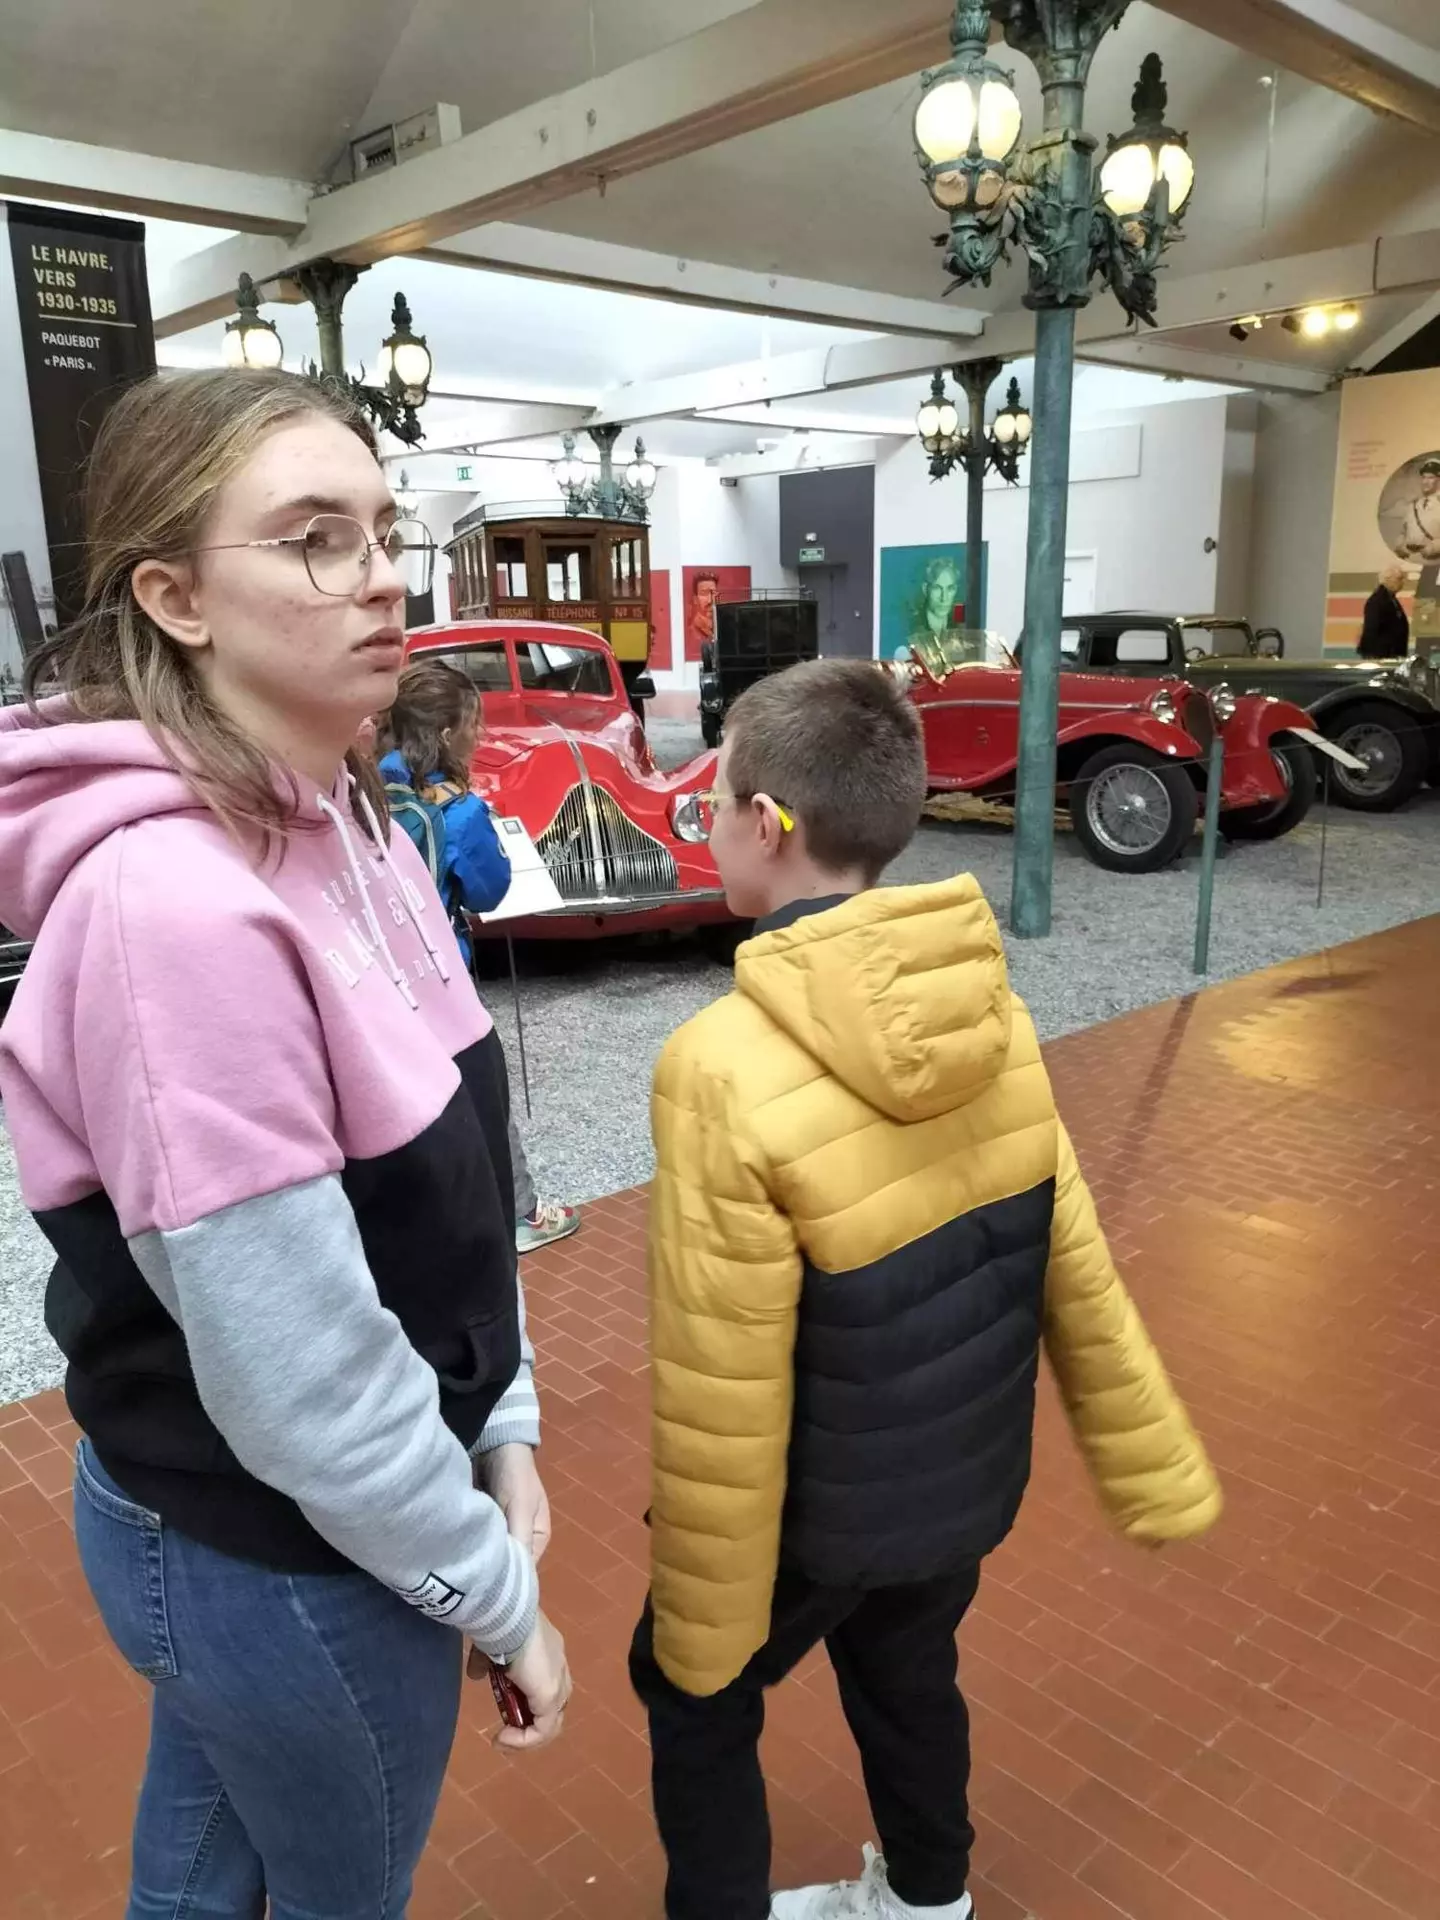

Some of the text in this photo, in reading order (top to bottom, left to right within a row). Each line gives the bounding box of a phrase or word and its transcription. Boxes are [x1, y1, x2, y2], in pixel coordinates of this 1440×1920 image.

[31, 244, 113, 272] LE HAVRE,
[33, 266, 77, 289] VERS
[37, 290, 117, 315] 1930-1935
[41, 331, 100, 349] PAQUEBOT
[52, 354, 86, 370] PARIS
